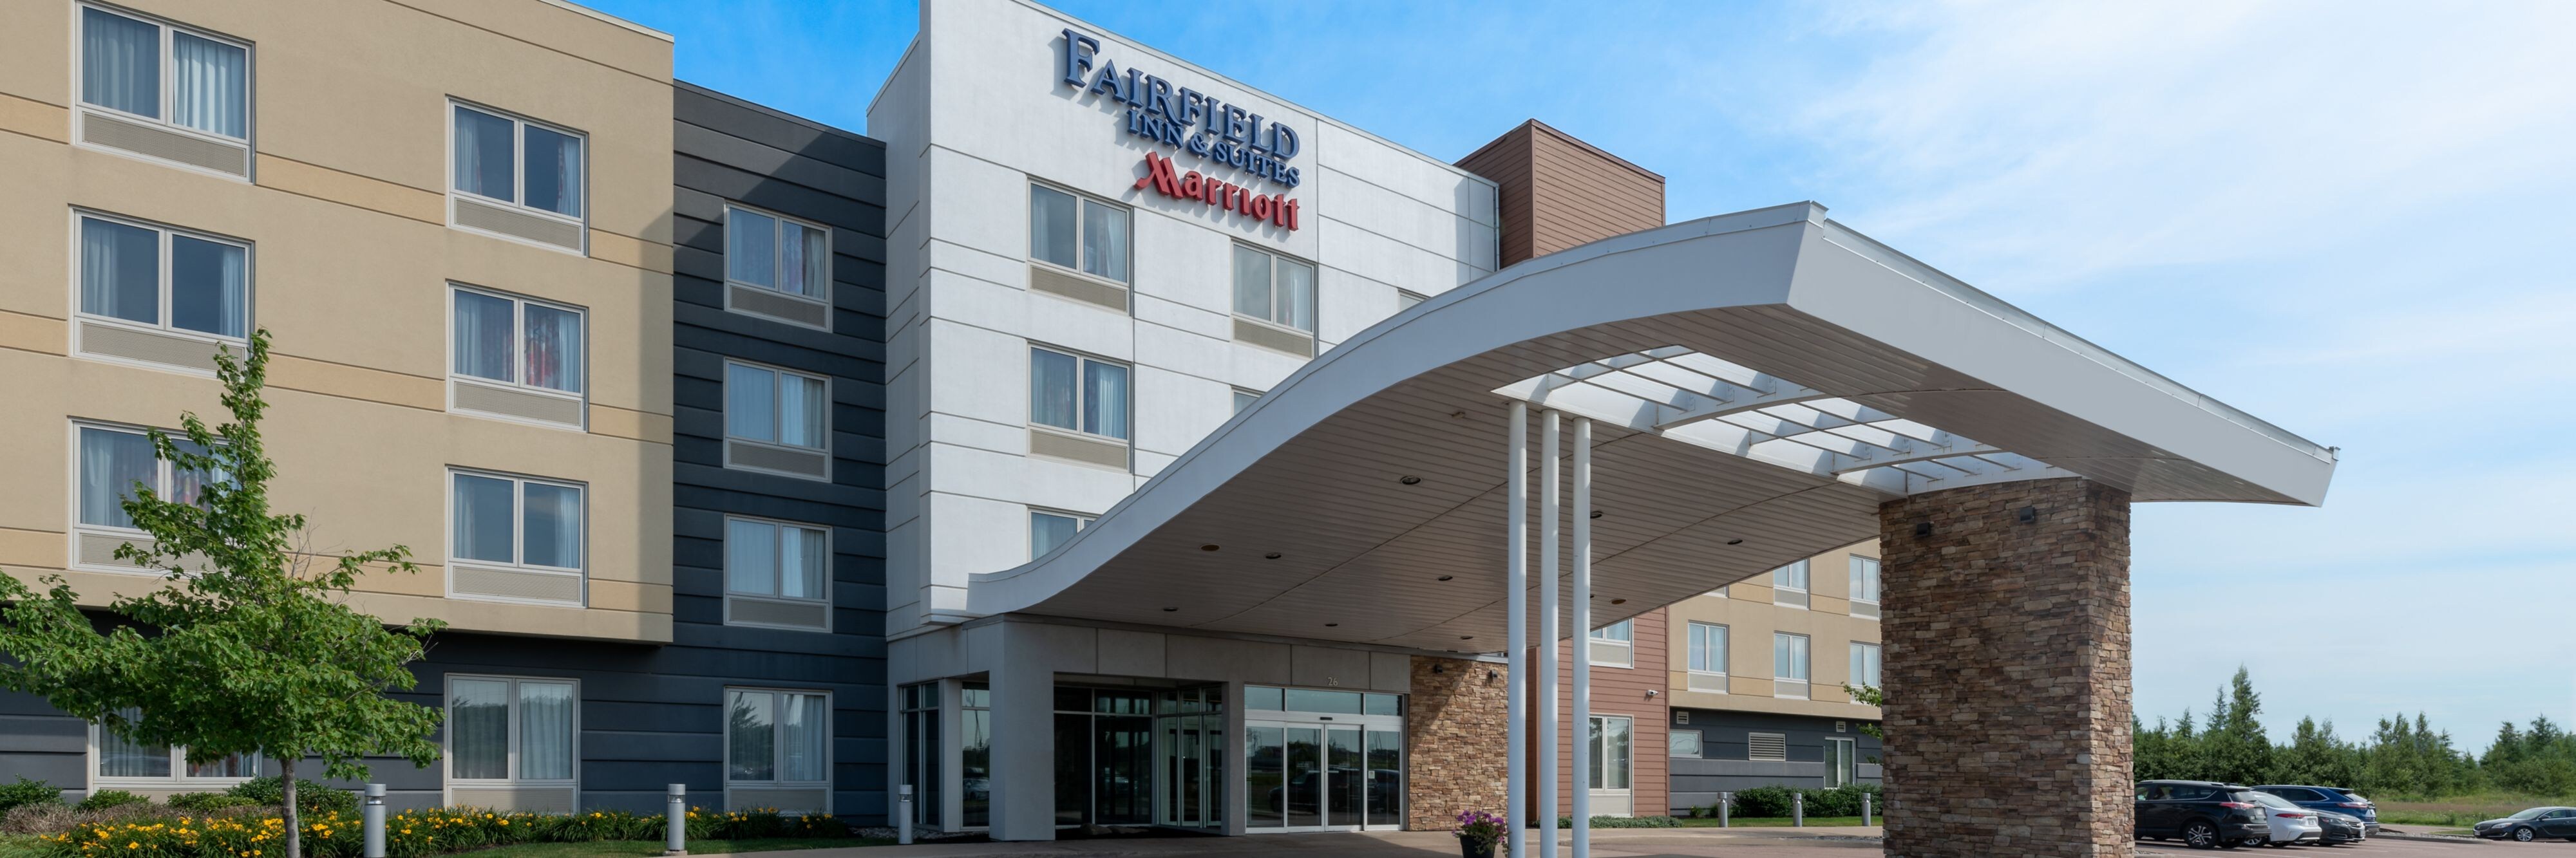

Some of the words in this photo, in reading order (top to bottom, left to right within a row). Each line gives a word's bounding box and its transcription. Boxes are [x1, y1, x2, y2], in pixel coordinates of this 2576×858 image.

[1063, 28, 1300, 160] FAIRFIELD
[1126, 109, 1184, 149] INN
[1186, 132, 1211, 158] &
[1212, 141, 1300, 188] SUITES
[1133, 151, 1299, 231] Marriott
[1327, 676, 1338, 686] 26
